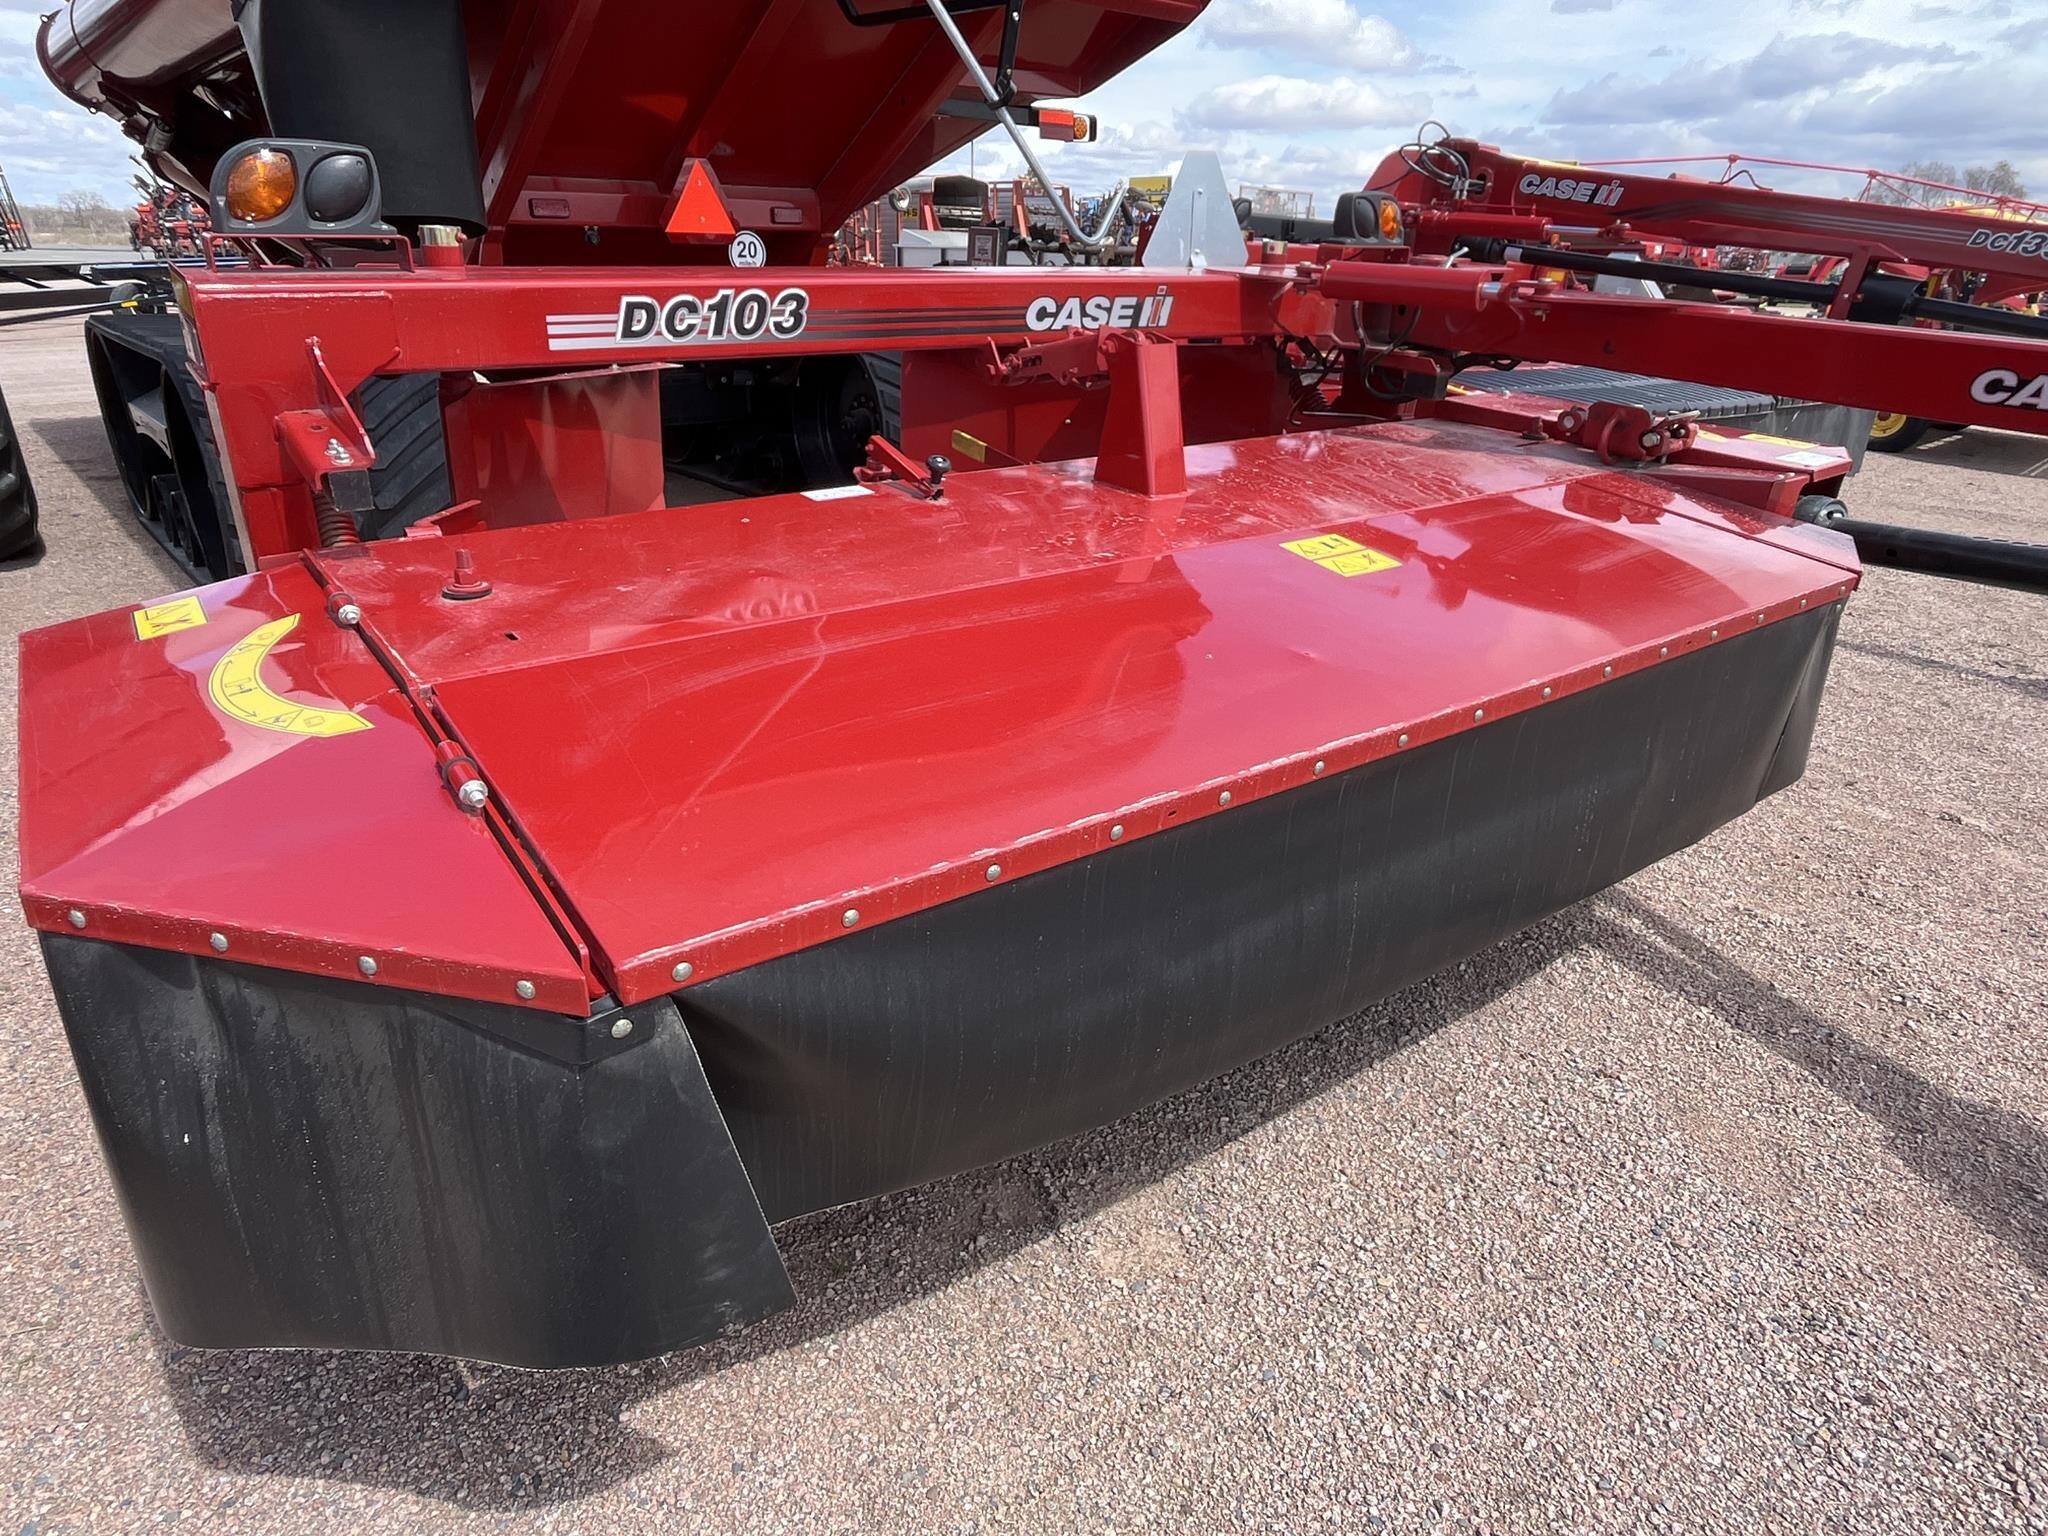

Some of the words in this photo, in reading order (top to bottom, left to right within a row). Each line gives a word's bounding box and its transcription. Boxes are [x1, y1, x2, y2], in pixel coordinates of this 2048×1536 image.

[1519, 174, 1596, 202] CASE
[737, 240, 757, 259] 20
[616, 288, 809, 343] DC103
[1025, 295, 1138, 331] CASE
